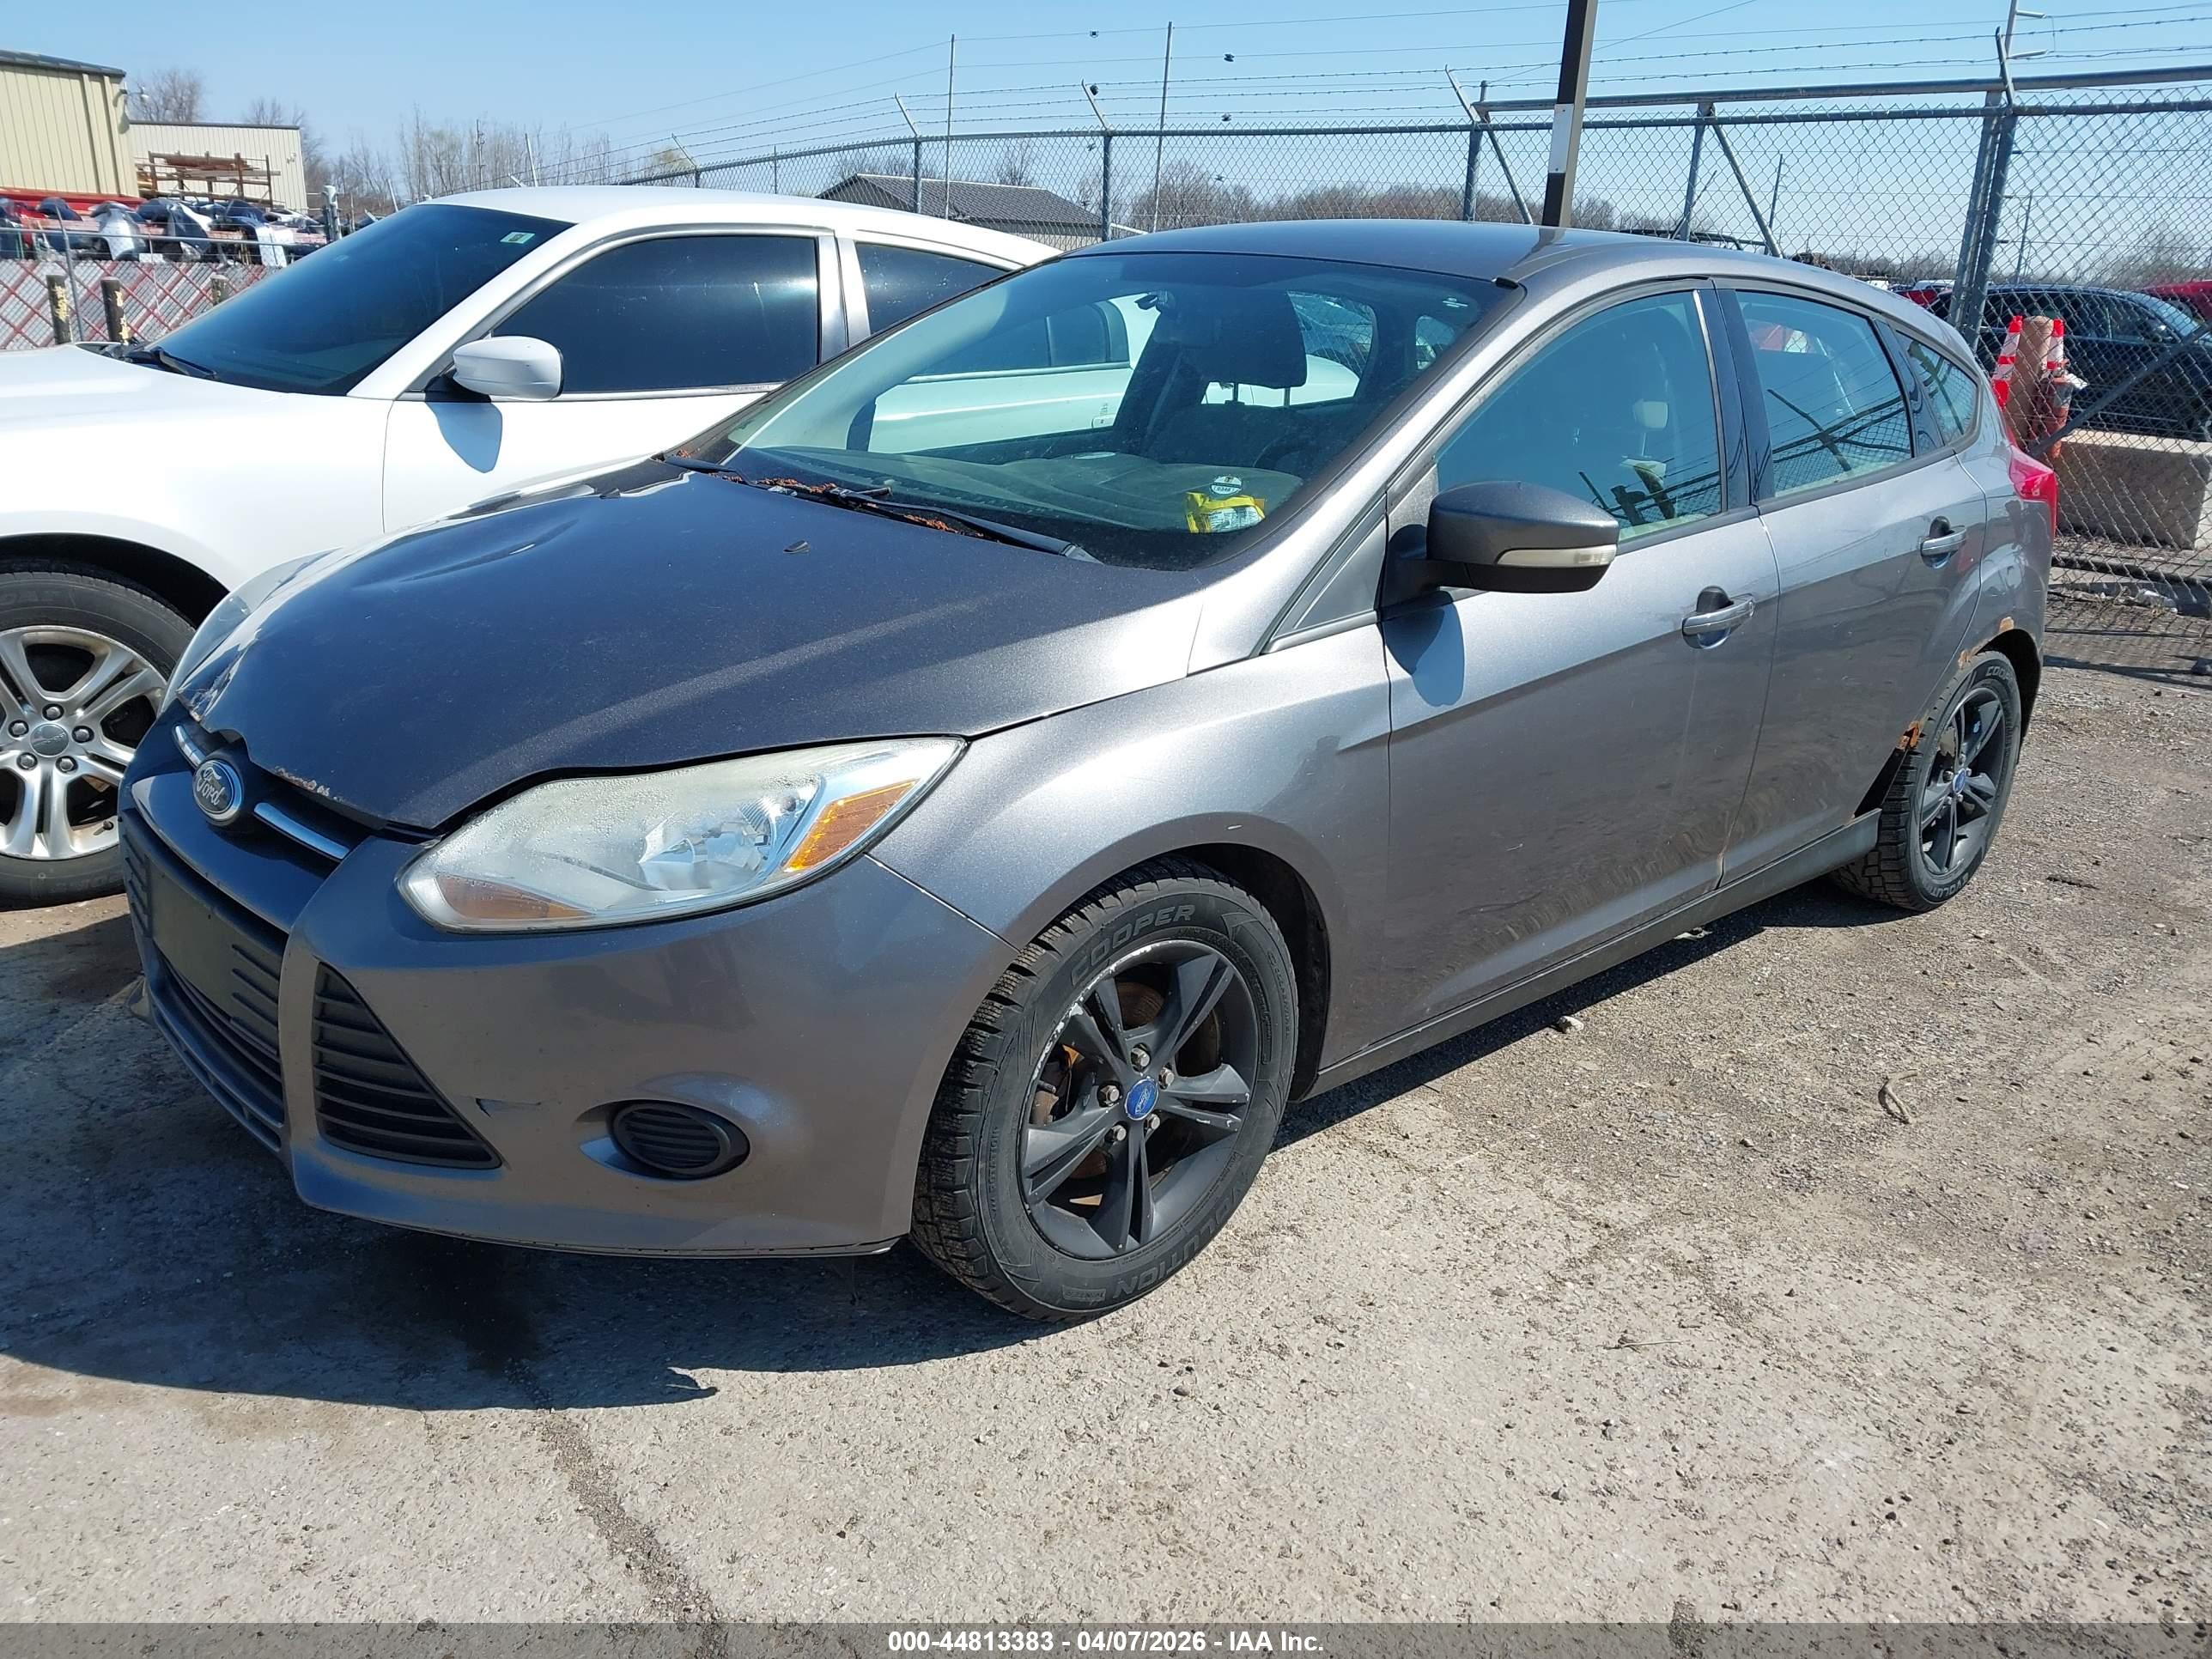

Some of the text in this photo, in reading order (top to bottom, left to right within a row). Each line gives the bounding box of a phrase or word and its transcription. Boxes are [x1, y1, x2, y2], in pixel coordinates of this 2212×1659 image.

[196, 766, 226, 806] Ford
[1071, 904, 1195, 986] COOPER
[1113, 1185, 1247, 1299] VOLUTION
